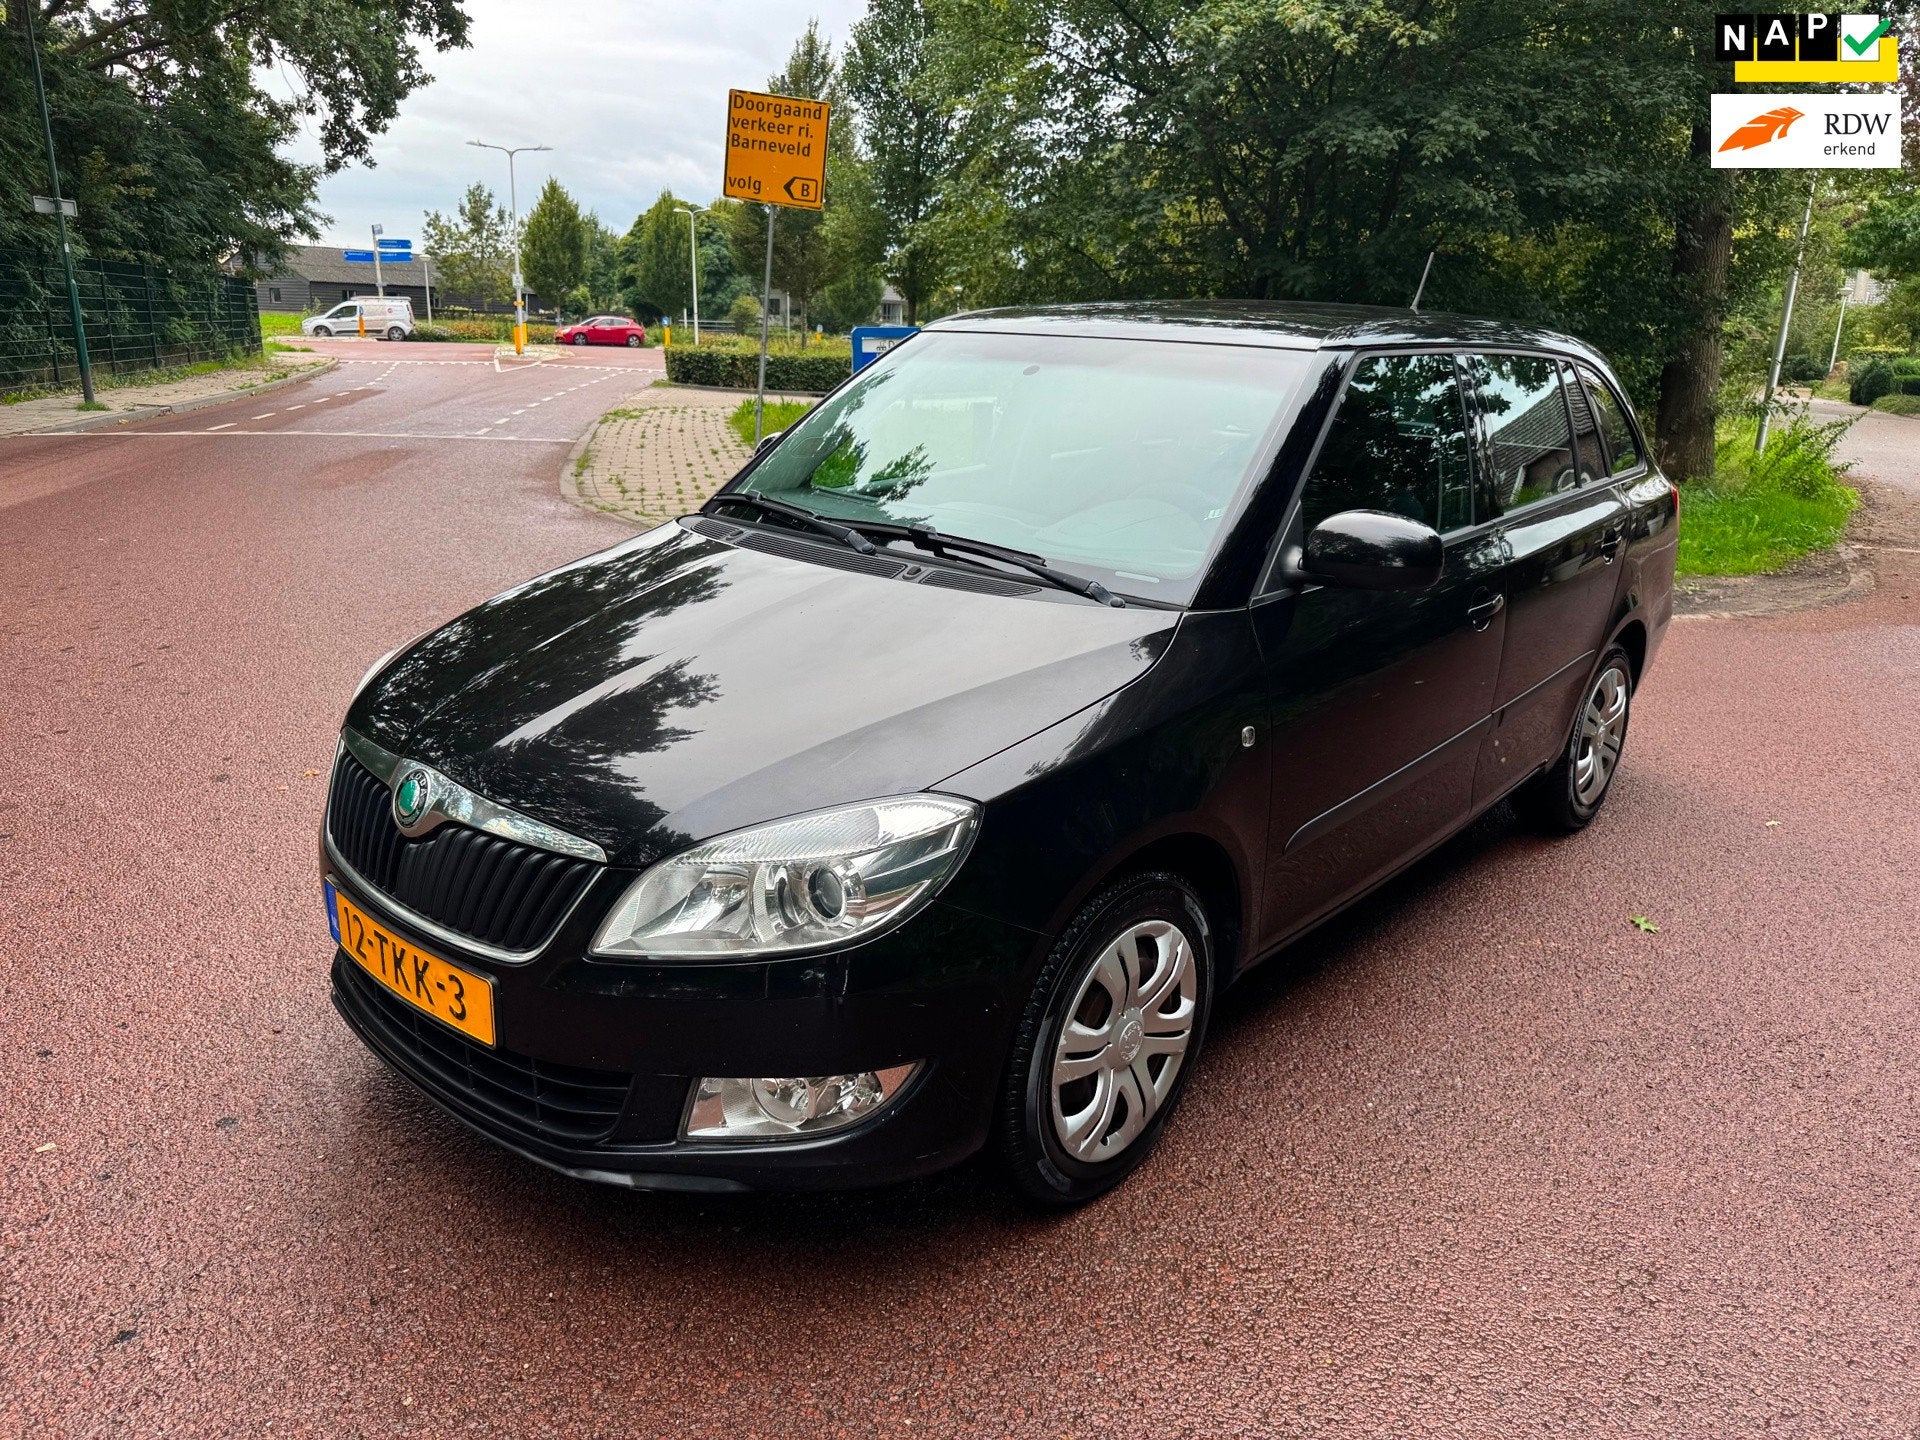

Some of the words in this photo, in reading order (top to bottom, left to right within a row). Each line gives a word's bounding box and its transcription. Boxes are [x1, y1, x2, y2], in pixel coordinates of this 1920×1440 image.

[733, 95, 822, 120] Doorgaand
[732, 117, 794, 135] verkeer
[798, 123, 814, 139] ri.
[731, 133, 811, 157] Barneveld
[728, 176, 762, 194] volg
[801, 183, 810, 197] B
[343, 906, 467, 1021] 12-TKK-3
